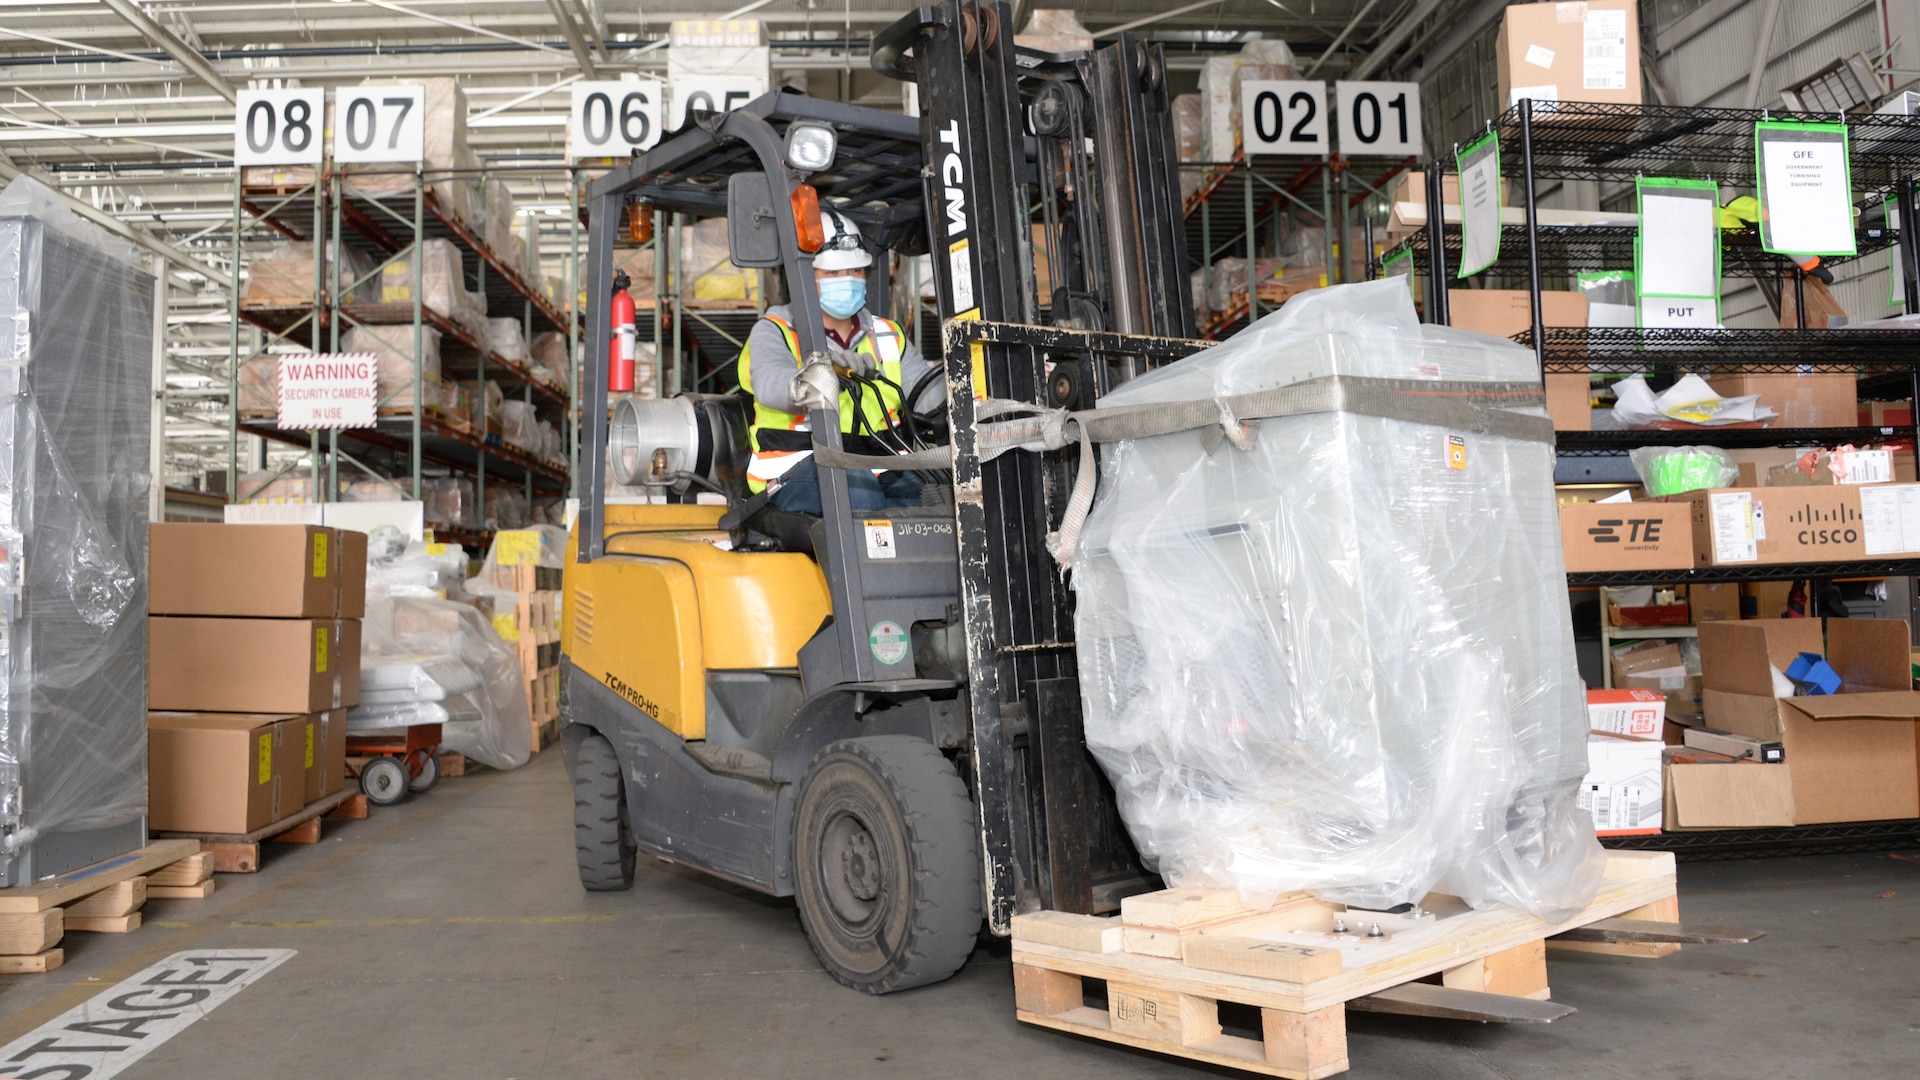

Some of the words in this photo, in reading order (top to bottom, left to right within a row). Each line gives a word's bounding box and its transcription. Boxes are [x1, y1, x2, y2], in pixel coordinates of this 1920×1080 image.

[246, 99, 312, 154] 08
[346, 97, 414, 151] 07
[583, 92, 650, 146] 06
[1254, 91, 1318, 143] 02
[1353, 92, 1408, 143] 01
[1793, 150, 1814, 159] GFE
[940, 119, 967, 237] TCM
[1668, 307, 1694, 317] PUT
[287, 363, 369, 380] WARNING
[285, 388, 329, 401] SECURITY
[331, 387, 371, 400] CAMERA
[312, 408, 321, 419] IN
[324, 407, 342, 419] USE
[1627, 518, 1663, 542] TE
[1797, 528, 1857, 545] CISCO
[1623, 544, 1660, 552] connectivity
[603, 671, 627, 696] TCM
[626, 686, 659, 718] PRO-HG
